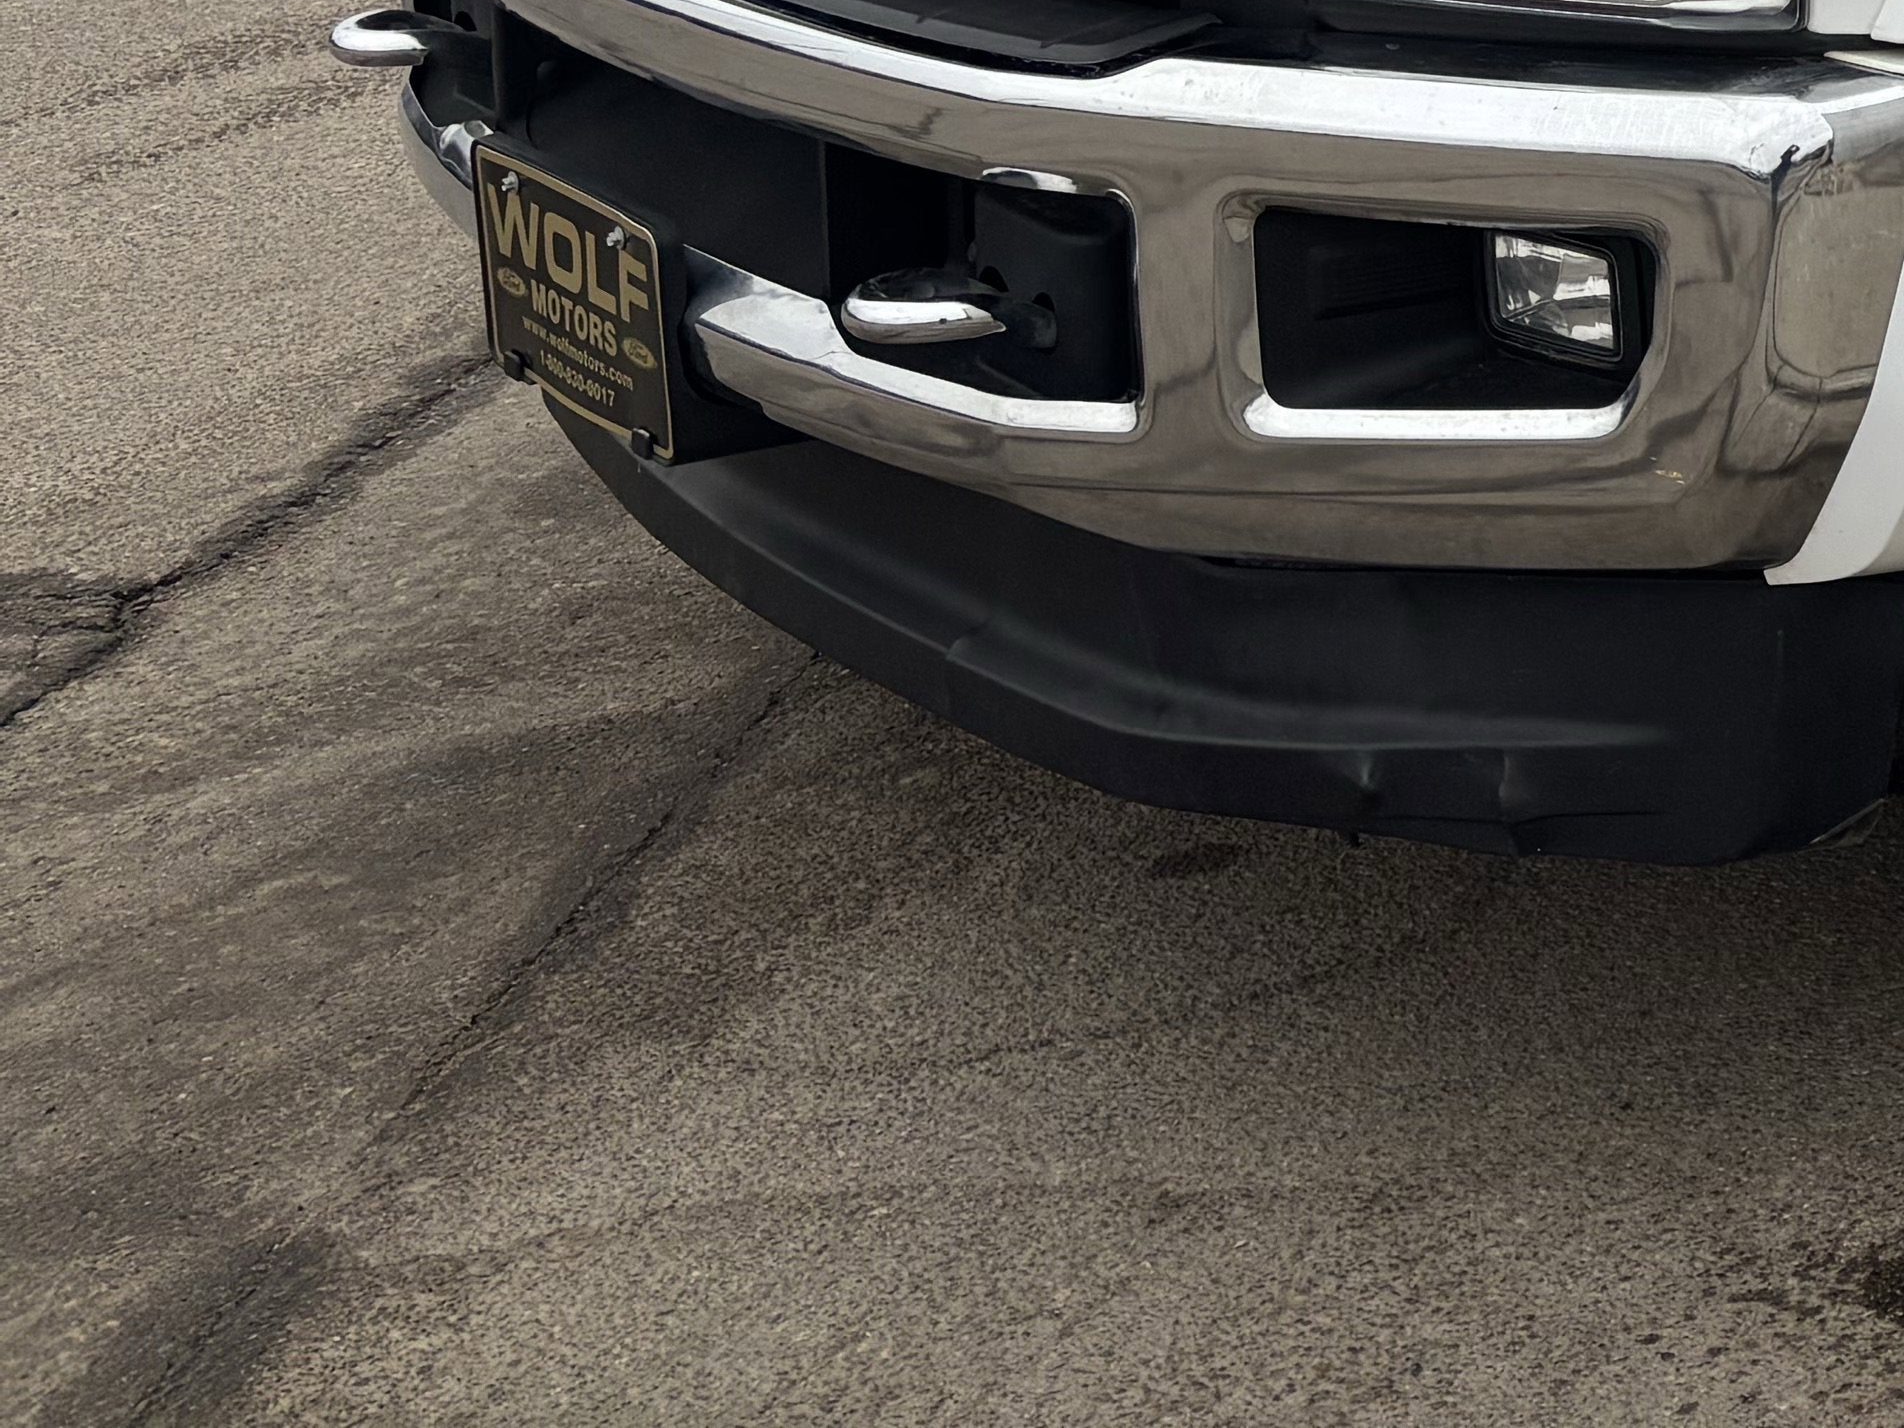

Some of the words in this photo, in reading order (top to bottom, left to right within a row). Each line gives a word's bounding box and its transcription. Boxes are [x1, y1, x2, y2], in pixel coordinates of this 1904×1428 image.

[487, 182, 650, 324] WOLF
[521, 316, 634, 391] www.wolfmotors.com
[530, 279, 618, 357] MOTORS
